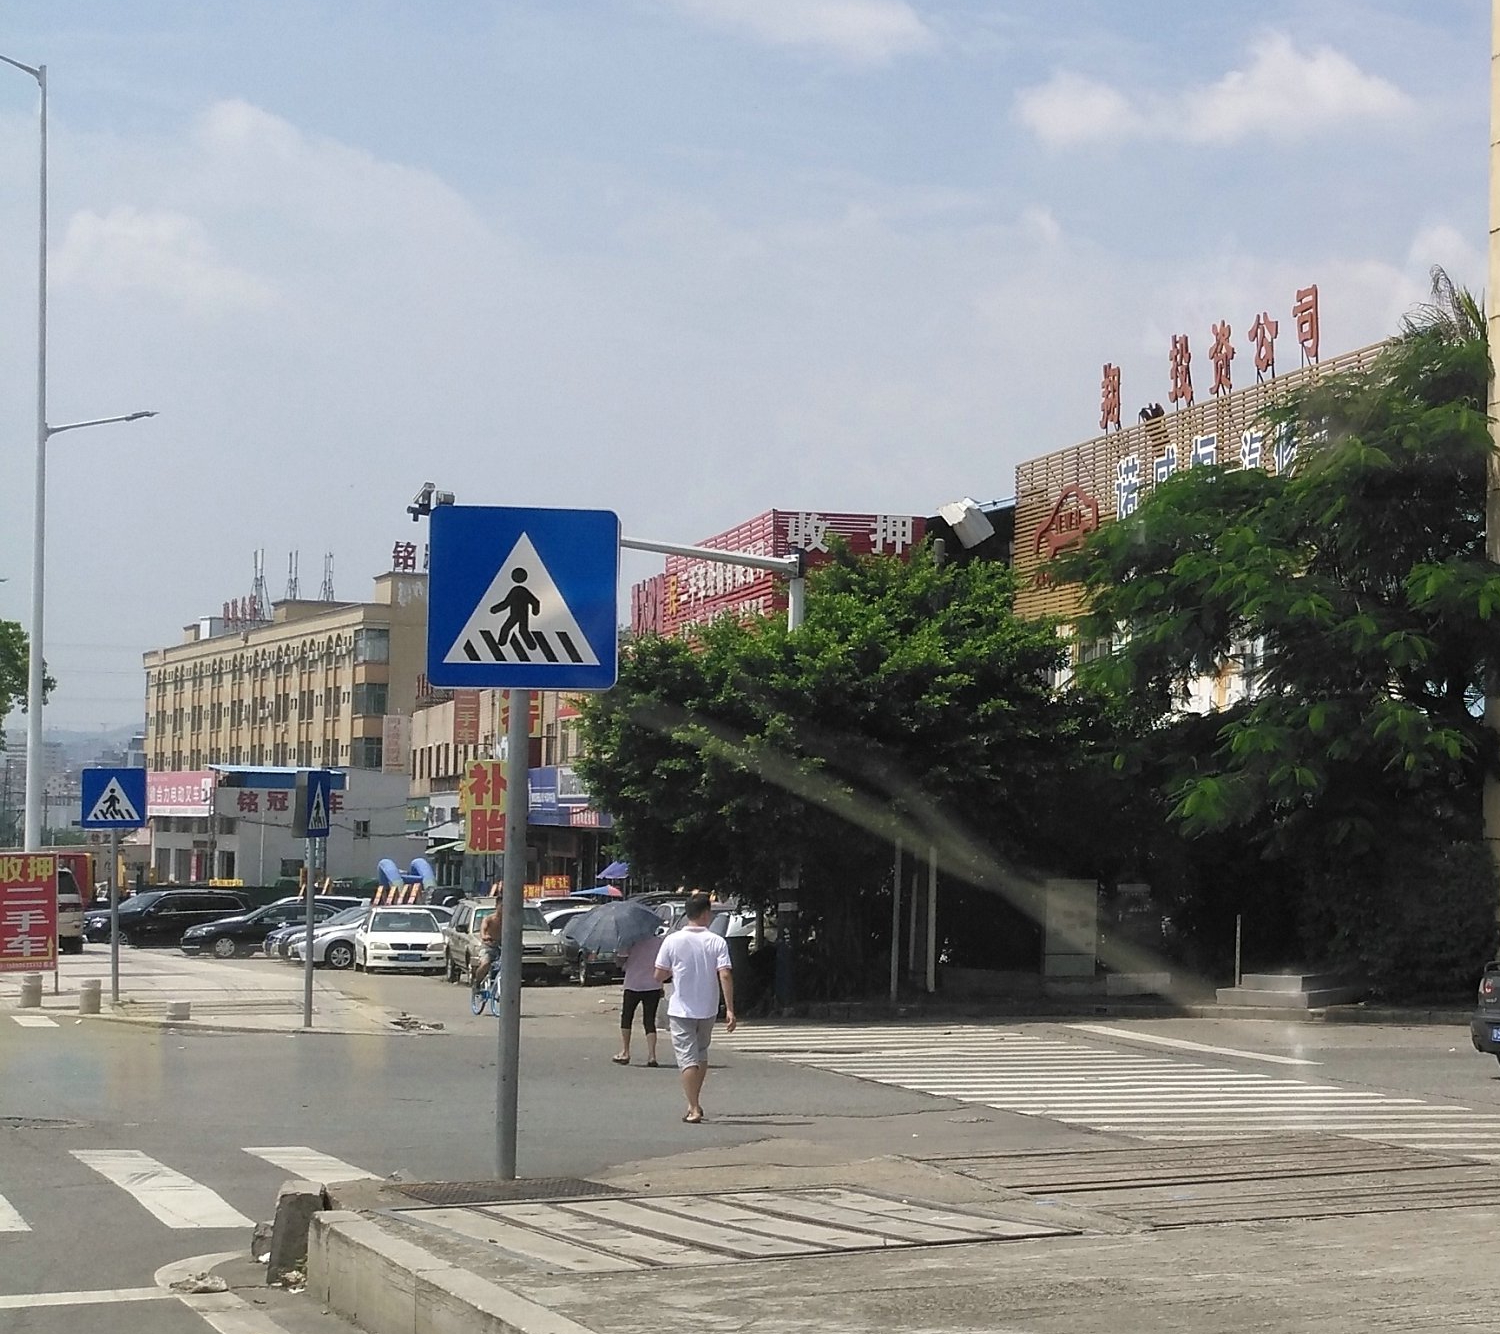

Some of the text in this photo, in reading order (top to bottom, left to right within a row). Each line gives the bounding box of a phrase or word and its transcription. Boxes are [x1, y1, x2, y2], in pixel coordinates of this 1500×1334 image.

[0, 856, 54, 883] 收押
[2, 887, 49, 957] 二手车
